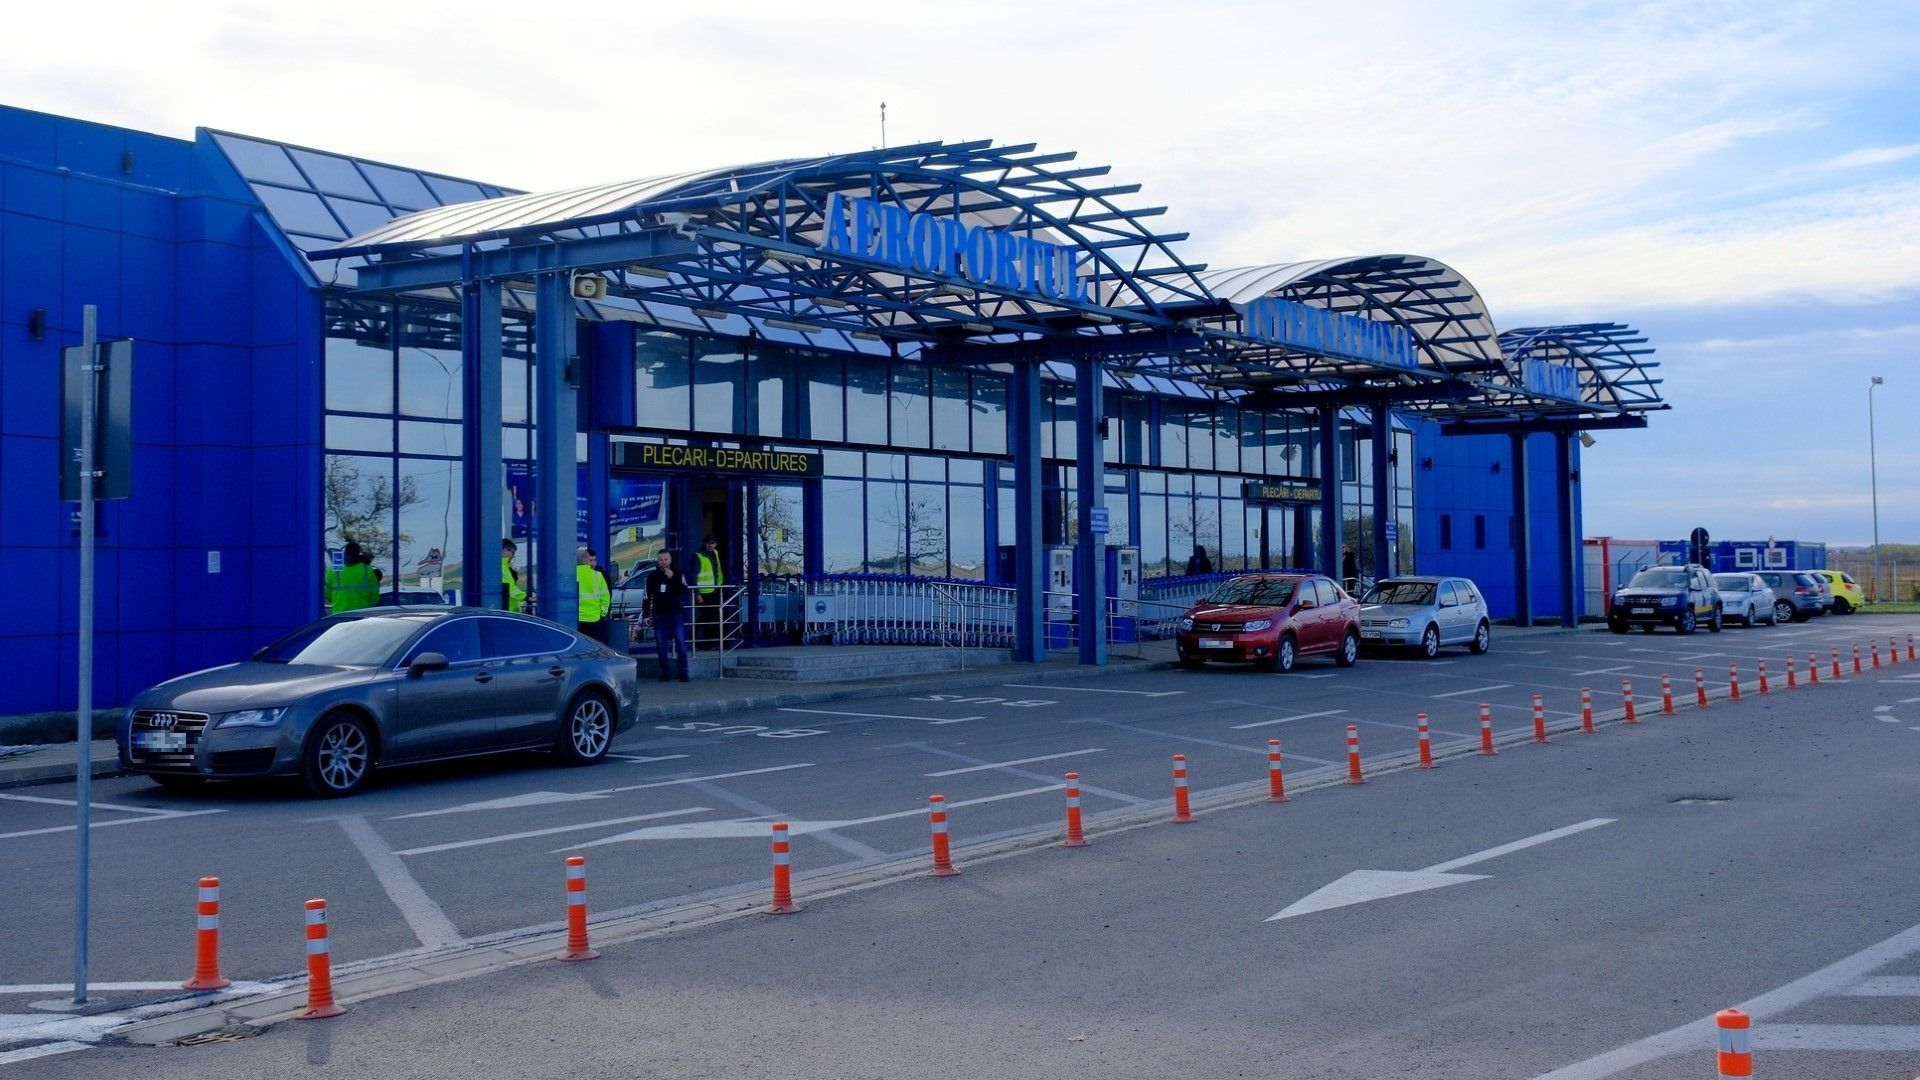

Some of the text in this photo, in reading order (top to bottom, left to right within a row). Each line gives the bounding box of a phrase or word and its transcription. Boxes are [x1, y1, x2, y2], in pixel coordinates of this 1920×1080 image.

[816, 191, 1088, 305] AEROPORTUL
[908, 694, 1060, 707] BUS
[655, 721, 831, 739] BUS
